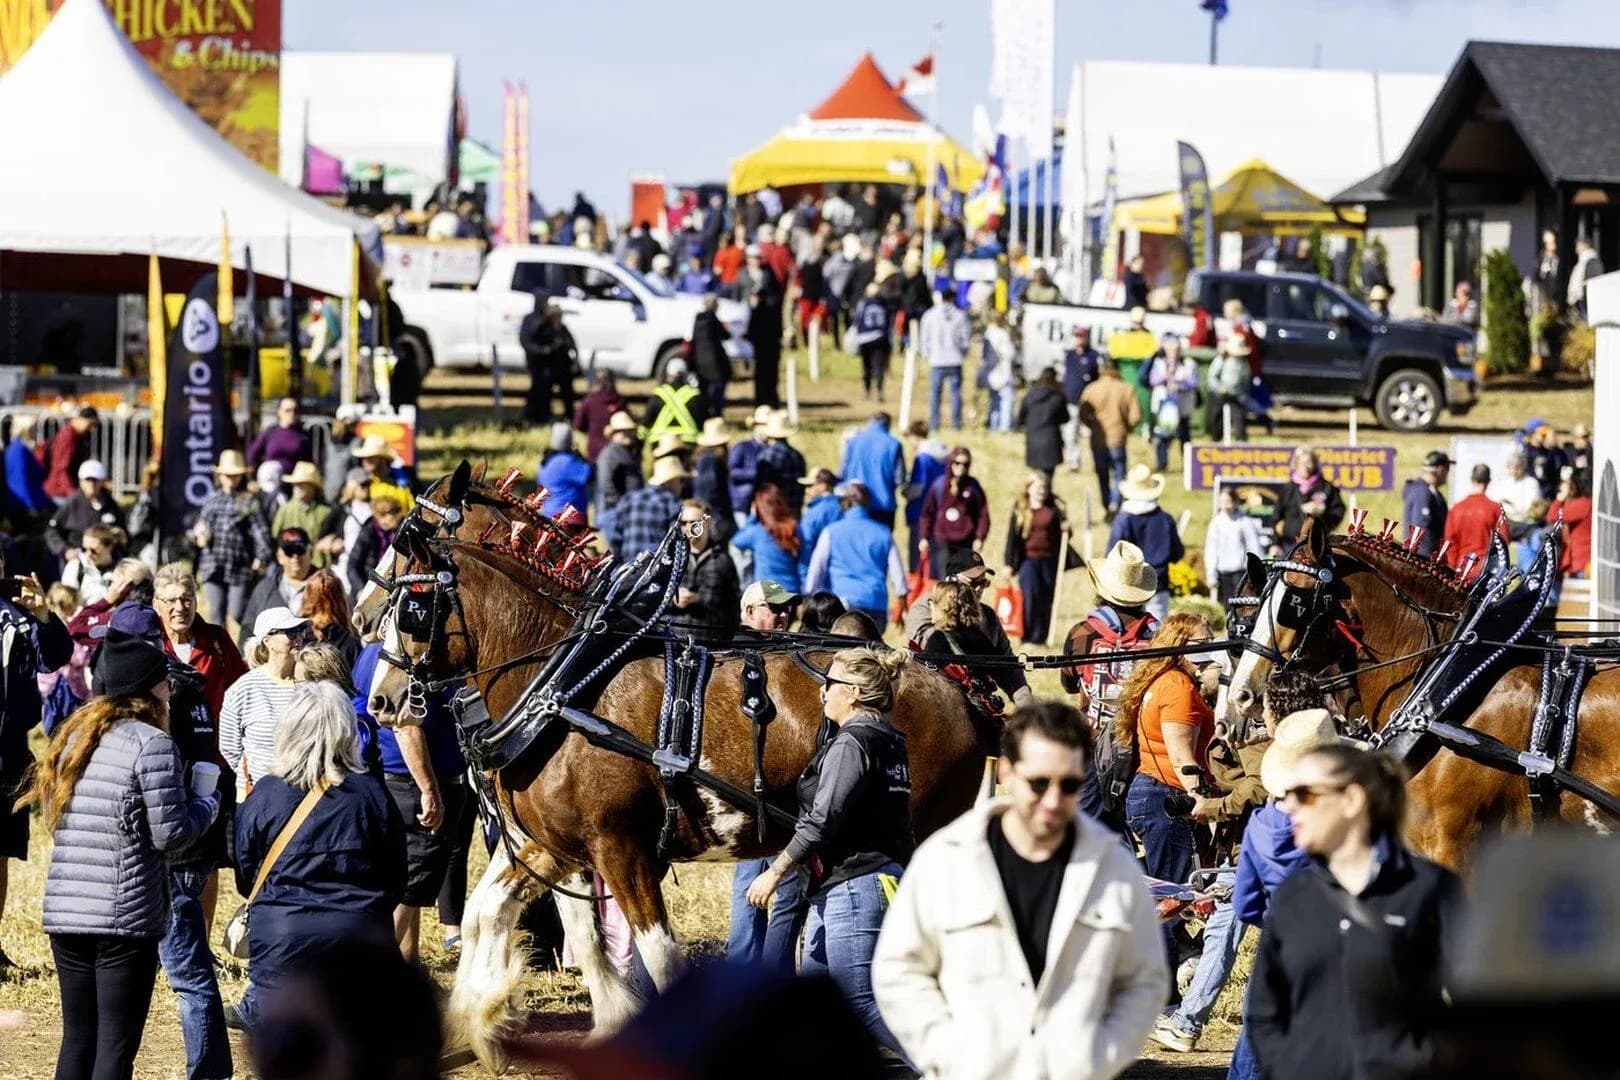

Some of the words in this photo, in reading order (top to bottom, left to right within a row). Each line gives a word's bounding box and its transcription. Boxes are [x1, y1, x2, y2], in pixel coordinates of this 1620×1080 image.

[106, 0, 253, 42] HICKEN
[171, 40, 194, 69] &
[183, 360, 213, 506] Ontario
[1197, 447, 1291, 465] Chepstow
[1322, 465, 1383, 488] LUB
